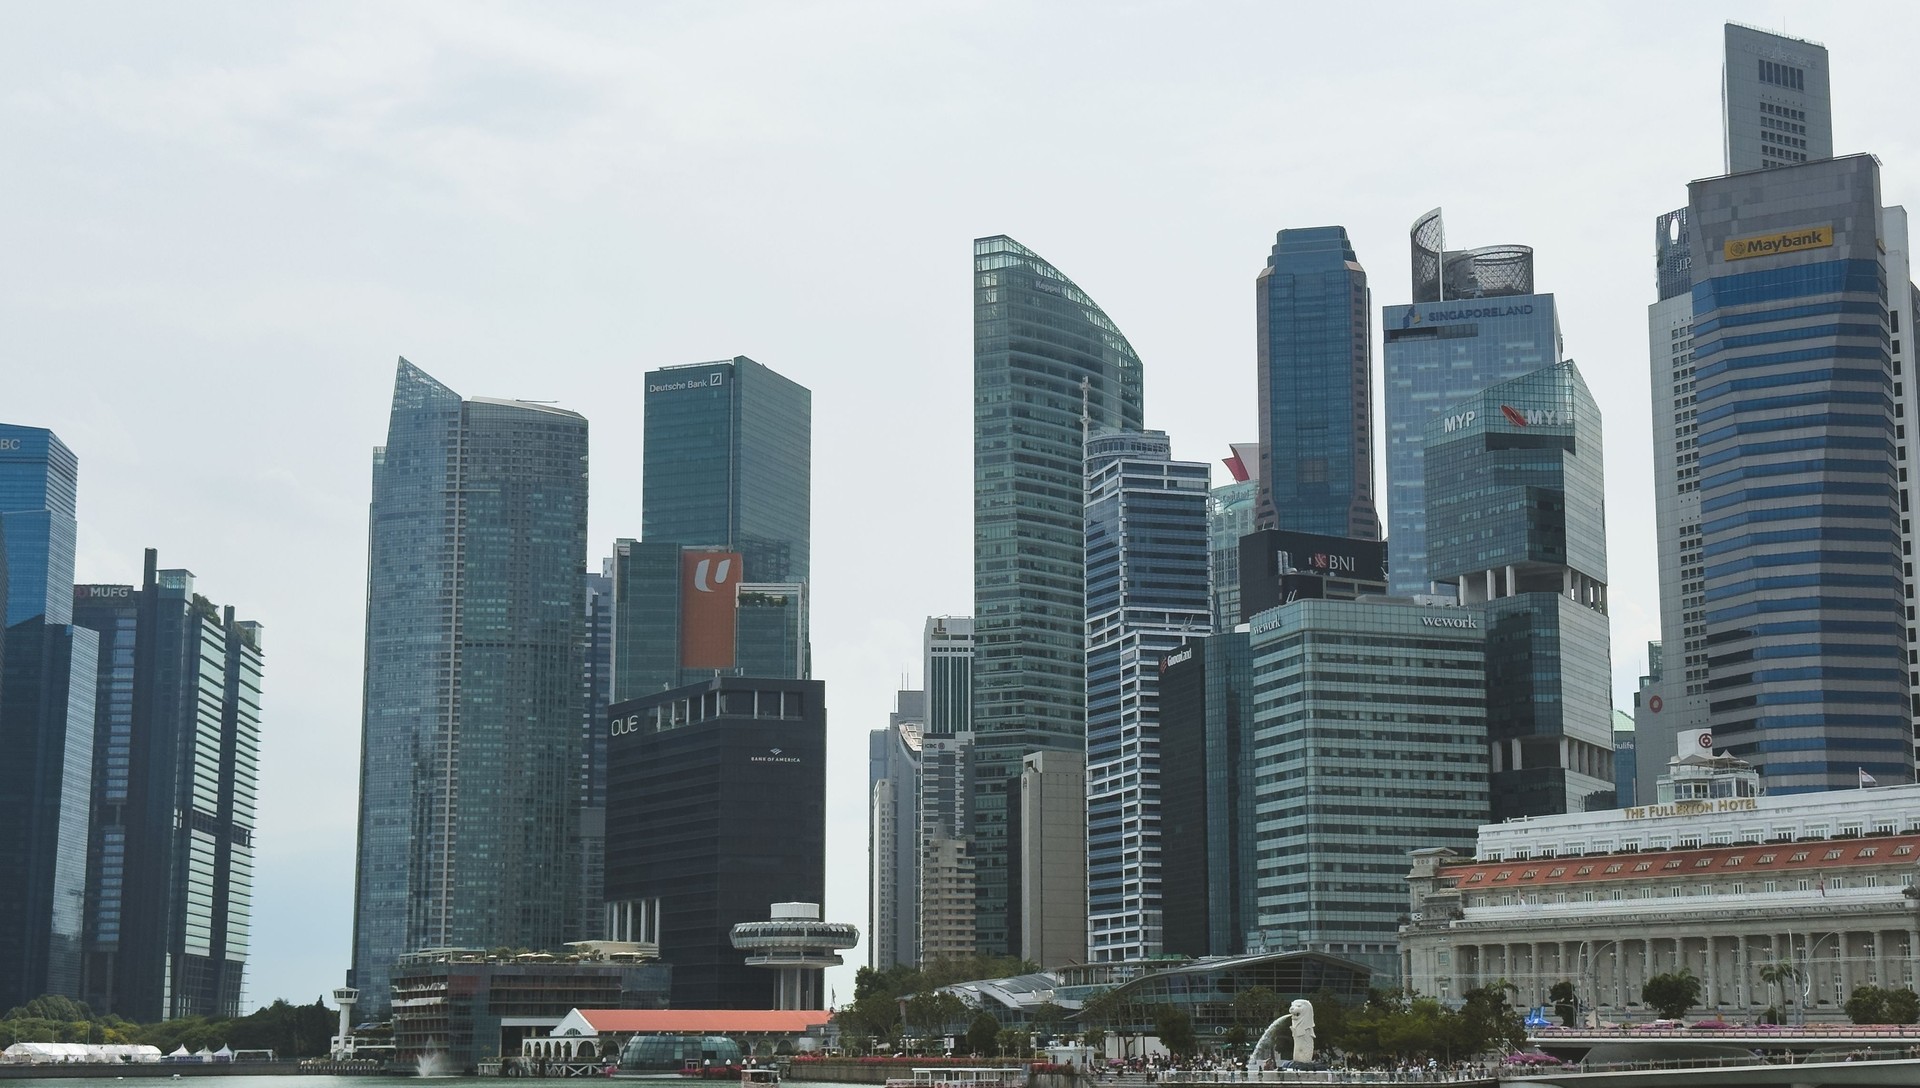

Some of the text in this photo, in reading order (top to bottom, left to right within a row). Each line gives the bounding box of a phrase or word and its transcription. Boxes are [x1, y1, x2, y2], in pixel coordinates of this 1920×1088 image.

[1747, 231, 1822, 252] Maybank
[649, 379, 708, 393] Deutsche Bank
[1444, 410, 1476, 433] MYP
[1527, 410, 1568, 425] MYP
[1329, 555, 1355, 572] BNI
[90, 587, 128, 598] MUFG
[1253, 614, 1281, 635] wework
[1422, 614, 1477, 629] wework
[611, 715, 639, 737] OUE
[1624, 799, 1758, 819] THE FULLERTON HOTEL
